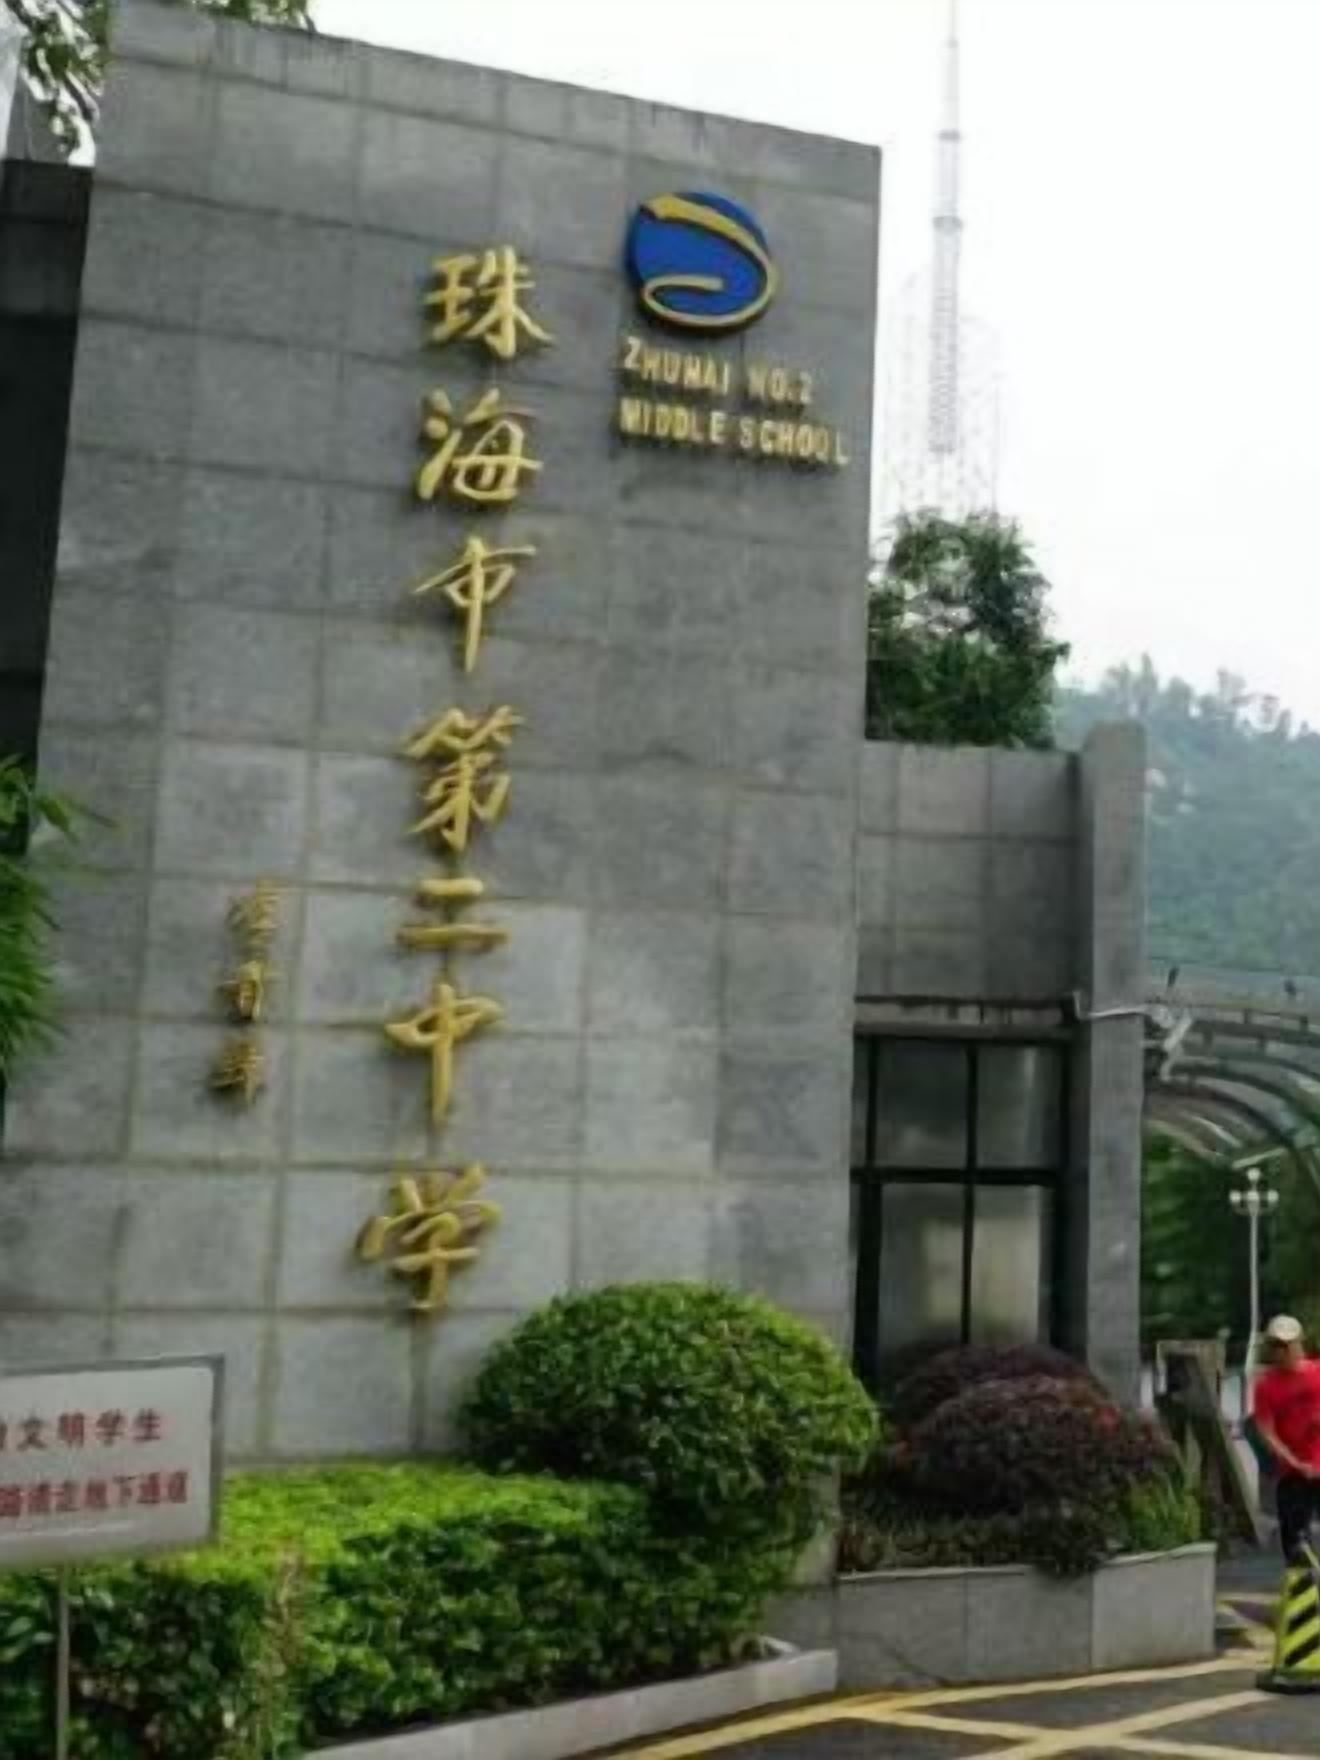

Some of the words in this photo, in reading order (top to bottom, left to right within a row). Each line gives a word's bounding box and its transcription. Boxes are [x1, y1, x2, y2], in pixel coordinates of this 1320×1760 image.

[623, 336, 729, 396] ZHUHAI
[620, 398, 727, 445] MIDDLE
[739, 415, 848, 466] SCHOOL
[359, 244, 556, 1314] 珠海市第二中学
